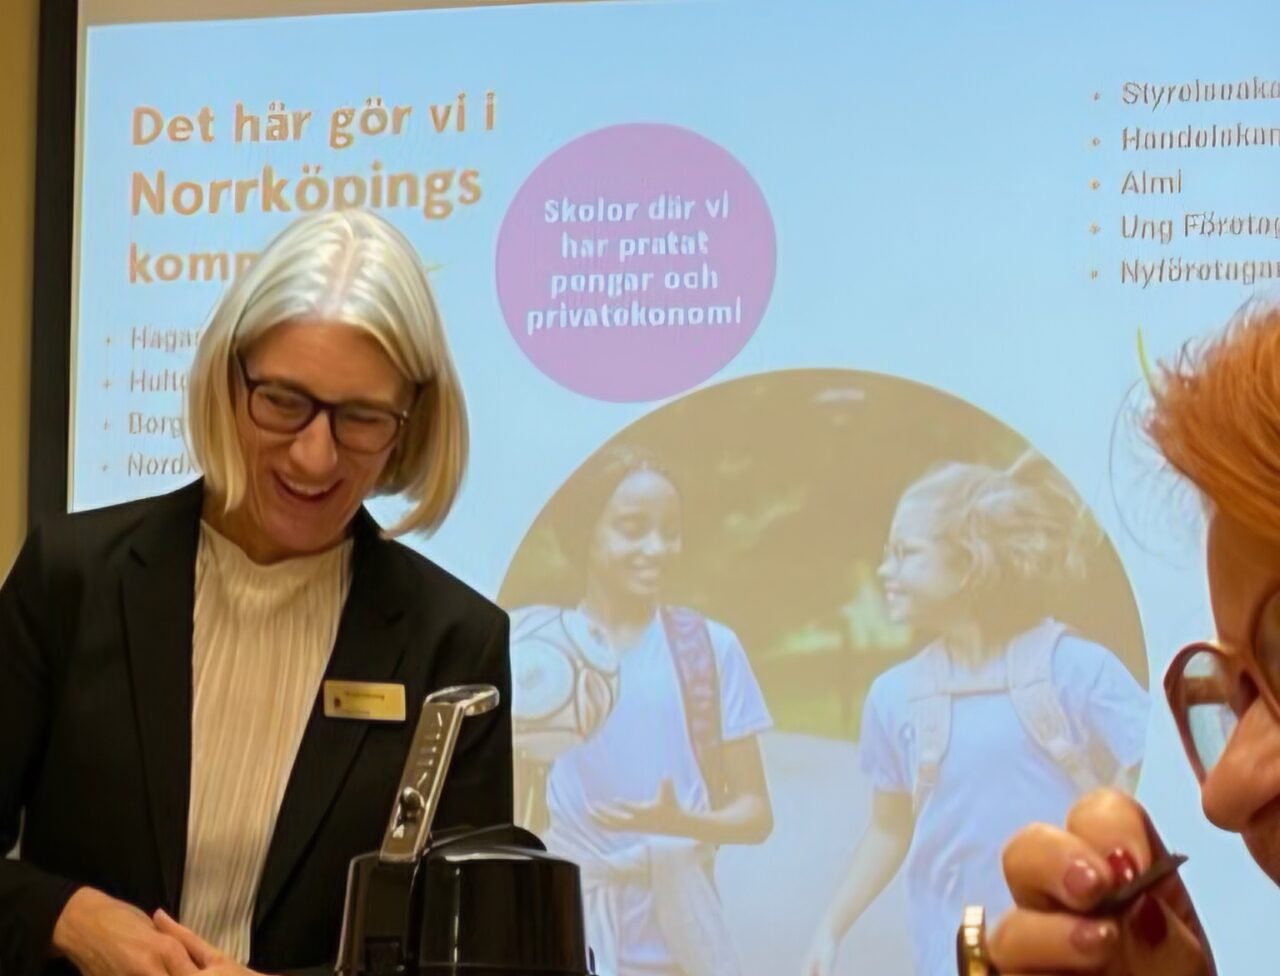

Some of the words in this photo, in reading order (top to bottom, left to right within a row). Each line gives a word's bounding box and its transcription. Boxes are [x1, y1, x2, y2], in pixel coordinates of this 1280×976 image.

[131, 104, 216, 145] Det
[234, 101, 312, 143] här
[329, 97, 412, 149] gör
[430, 92, 467, 133] vi
[484, 91, 496, 131] i
[131, 161, 482, 220] Norrköpings
[1122, 214, 1173, 245] Ung
